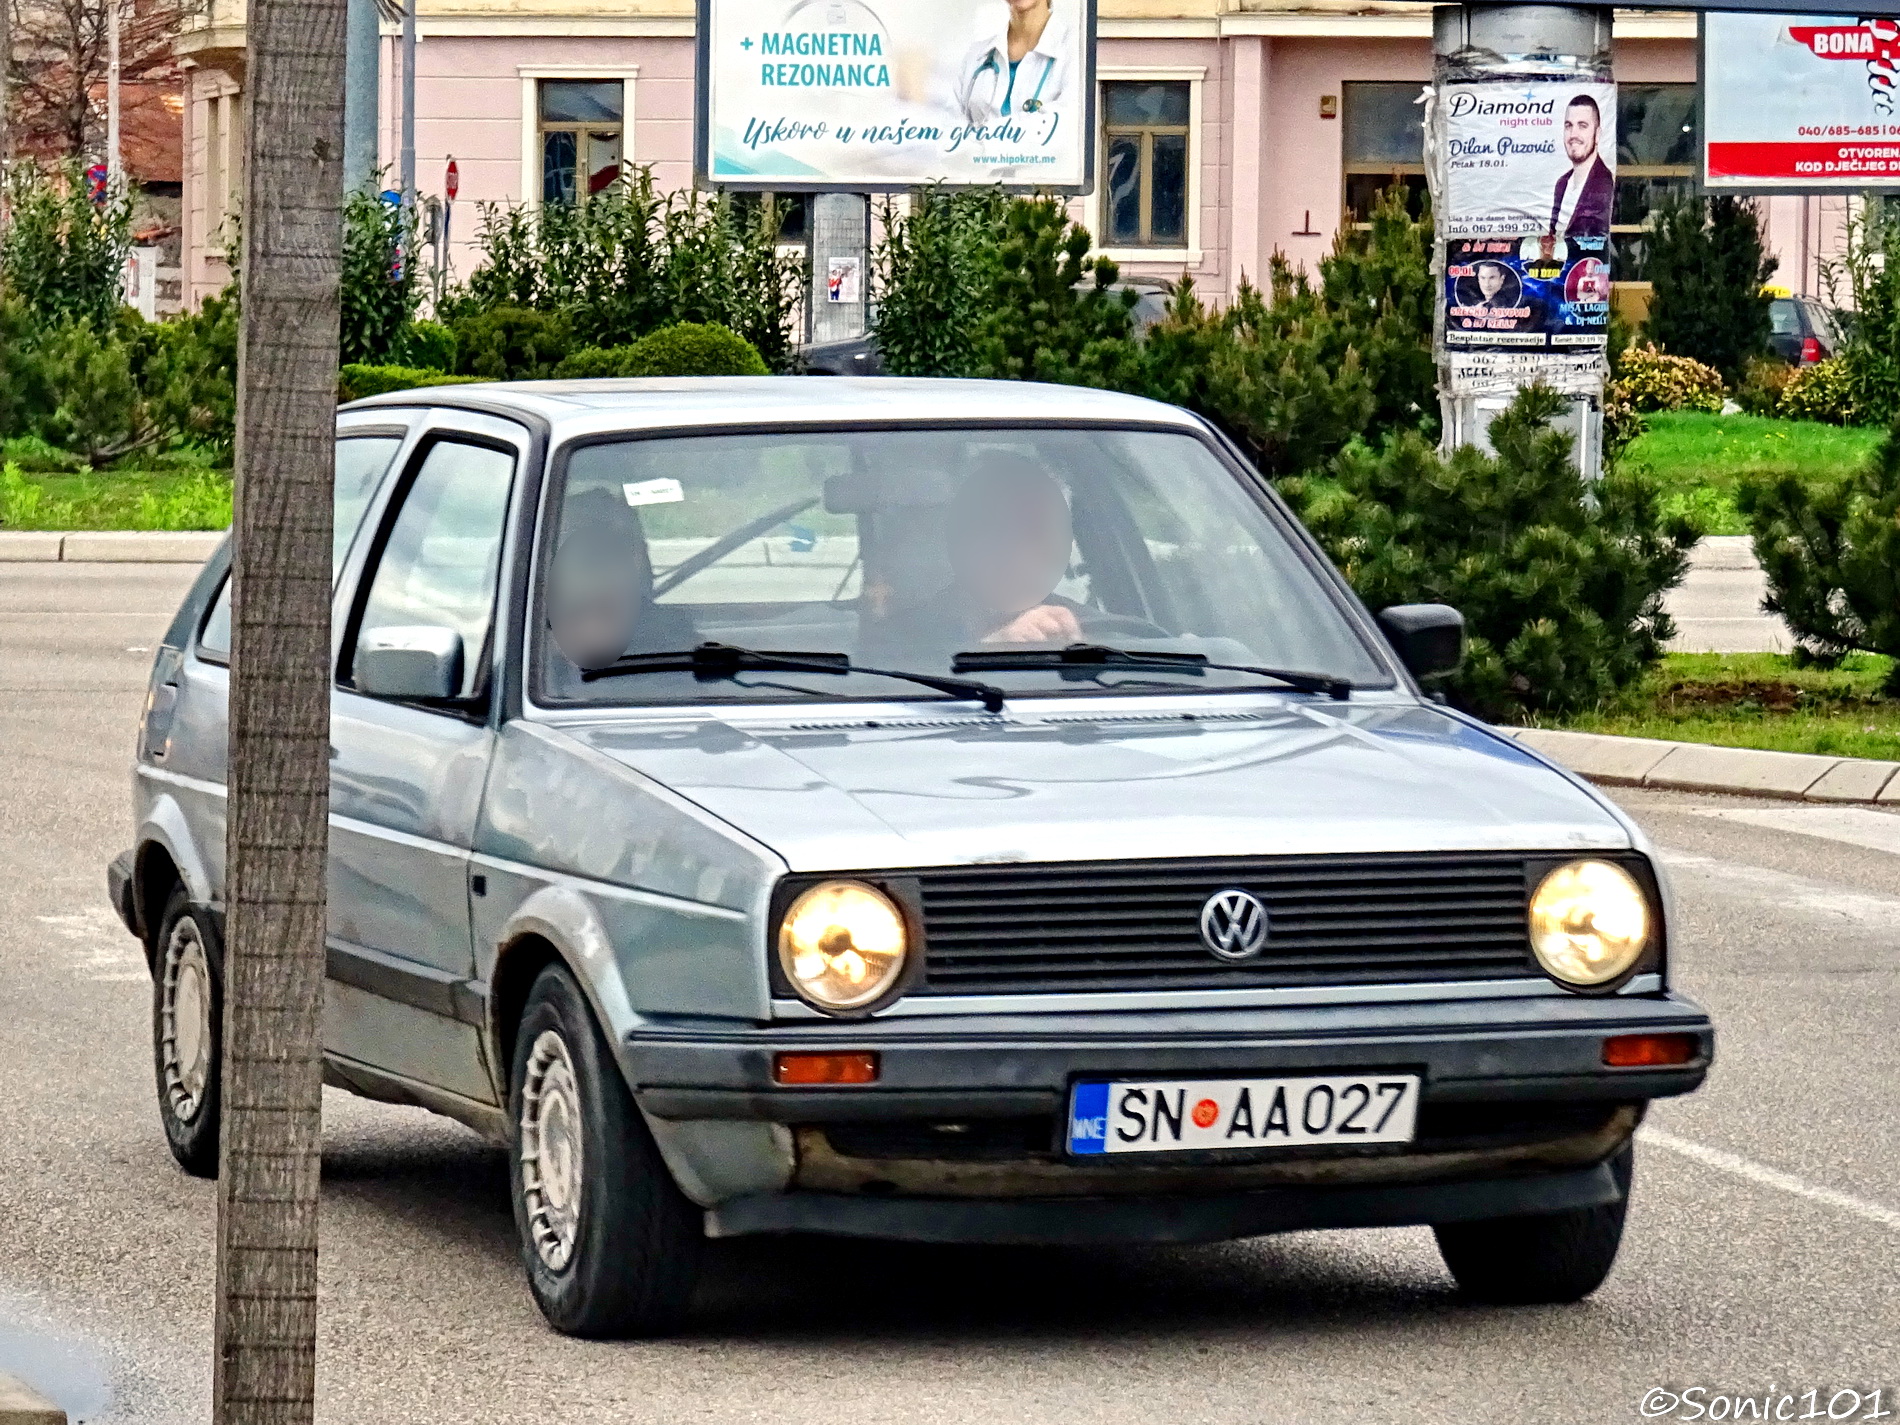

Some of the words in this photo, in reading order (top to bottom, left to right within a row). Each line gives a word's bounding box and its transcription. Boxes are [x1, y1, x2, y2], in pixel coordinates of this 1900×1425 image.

[761, 32, 882, 56] MAGNETNA
[1813, 32, 1875, 54] BONA
[761, 63, 890, 87] REZONANCA
[1449, 91, 1555, 118] Diamond
[1500, 118, 1528, 129] night
[1531, 118, 1553, 126] club
[1798, 125, 1880, 136] 040/685-685
[1882, 124, 1887, 135] i
[743, 116, 829, 151] Uskoro
[835, 125, 856, 144] u
[861, 117, 943, 145] našem
[945, 117, 1026, 153] gradu
[1449, 137, 1494, 157] Dilan
[1497, 136, 1556, 156] Puzović
[973, 153, 1056, 166] www.hipokrat.me
[1451, 160, 1475, 169] Petak
[1479, 159, 1508, 168] 18.01.
[1795, 162, 1823, 172] KOD
[1825, 158, 1887, 171] DJEČIJEG
[1448, 224, 1469, 234] Info
[1472, 223, 1494, 234] 067
